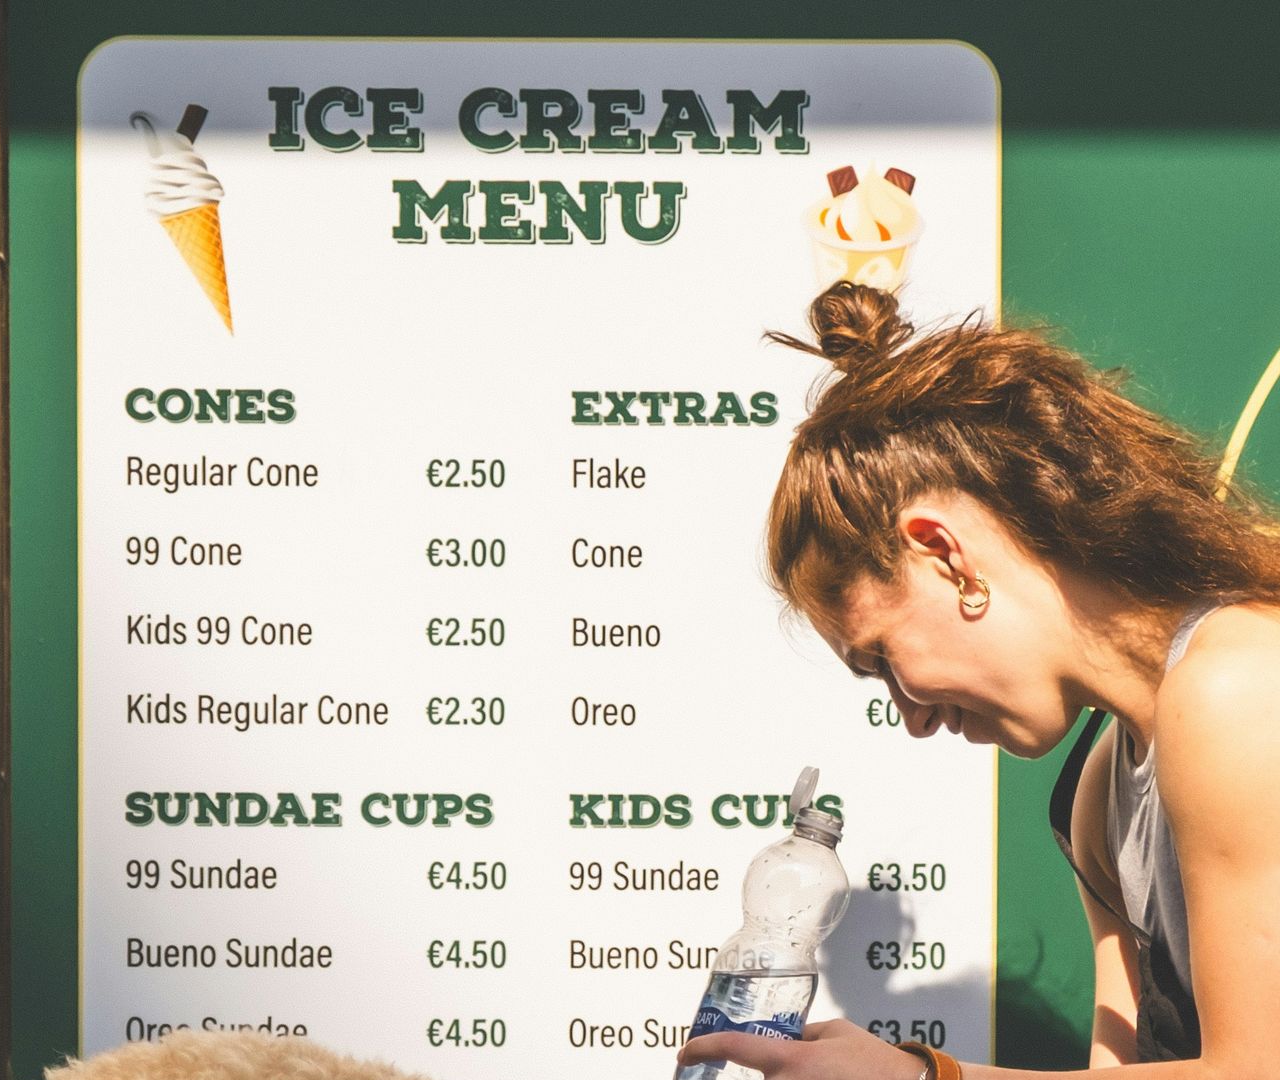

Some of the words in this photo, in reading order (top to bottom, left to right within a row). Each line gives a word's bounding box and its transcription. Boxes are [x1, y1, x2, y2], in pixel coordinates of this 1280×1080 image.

[267, 85, 426, 154] ICE
[457, 86, 811, 156] CREAM
[391, 178, 688, 247] MENU
[124, 387, 297, 426] CONES
[570, 390, 780, 428] EXTRAS
[127, 455, 237, 494] Regular
[247, 456, 318, 488] Cone
[426, 459, 505, 488] €2.50
[573, 458, 646, 489] Flake
[126, 536, 159, 566] 99
[171, 536, 242, 566] Cone
[426, 538, 505, 567] €3.00
[572, 538, 642, 568] Cone
[127, 614, 187, 645] Kids
[196, 614, 230, 645] 99
[242, 616, 312, 645] Cone
[426, 618, 505, 646] €2.50
[573, 618, 660, 647] Bueno
[127, 693, 187, 724] Kids
[198, 694, 308, 732] Regular
[318, 695, 388, 725] Cone
[426, 697, 505, 725] €2.30
[572, 696, 636, 726] Oreo
[124, 790, 342, 829] SUNDAE
[361, 791, 495, 830] CUPS
[568, 793, 694, 830] KIDS
[126, 858, 160, 889] 99
[170, 858, 277, 889] Sundae
[427, 861, 506, 890] €4.50
[570, 861, 602, 890] 99
[613, 860, 719, 891] Sundae
[867, 863, 946, 892] €3.50
[127, 937, 216, 968] Bueno
[226, 937, 332, 968] Sundae
[427, 940, 506, 968] €4.50
[569, 940, 658, 970] Bueno
[866, 941, 946, 971] €3.50
[427, 1019, 506, 1047] €4.50
[569, 1018, 633, 1048] Oreo
